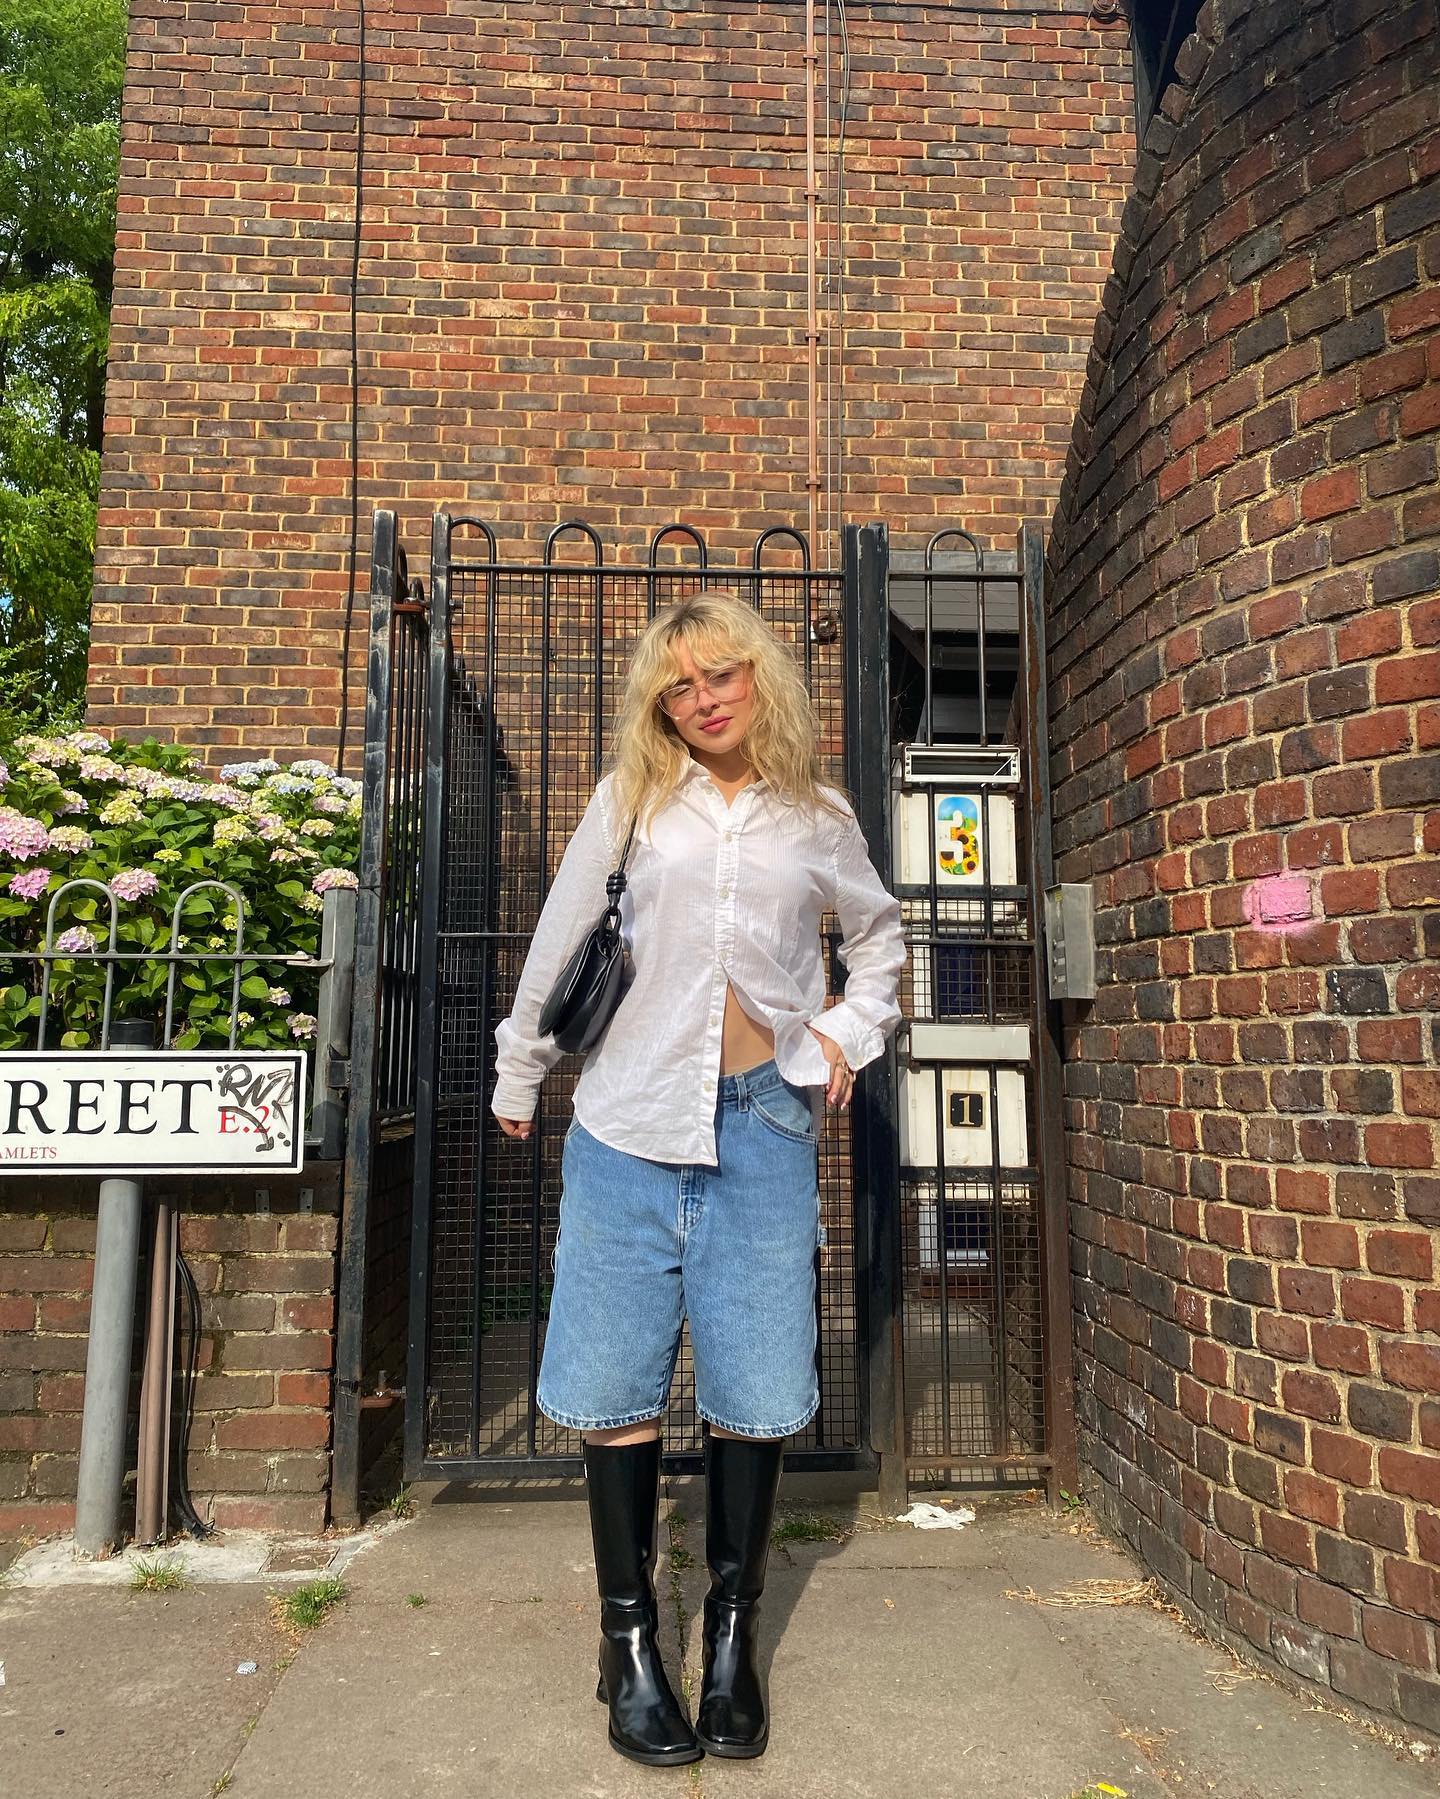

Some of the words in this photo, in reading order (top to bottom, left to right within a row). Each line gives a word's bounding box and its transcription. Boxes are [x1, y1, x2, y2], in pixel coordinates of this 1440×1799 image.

[938, 796, 979, 875] 3
[2, 1079, 213, 1135] REET
[218, 1105, 271, 1134] E.2
[958, 1095, 975, 1125] 1
[0, 1146, 58, 1160] MLETS
